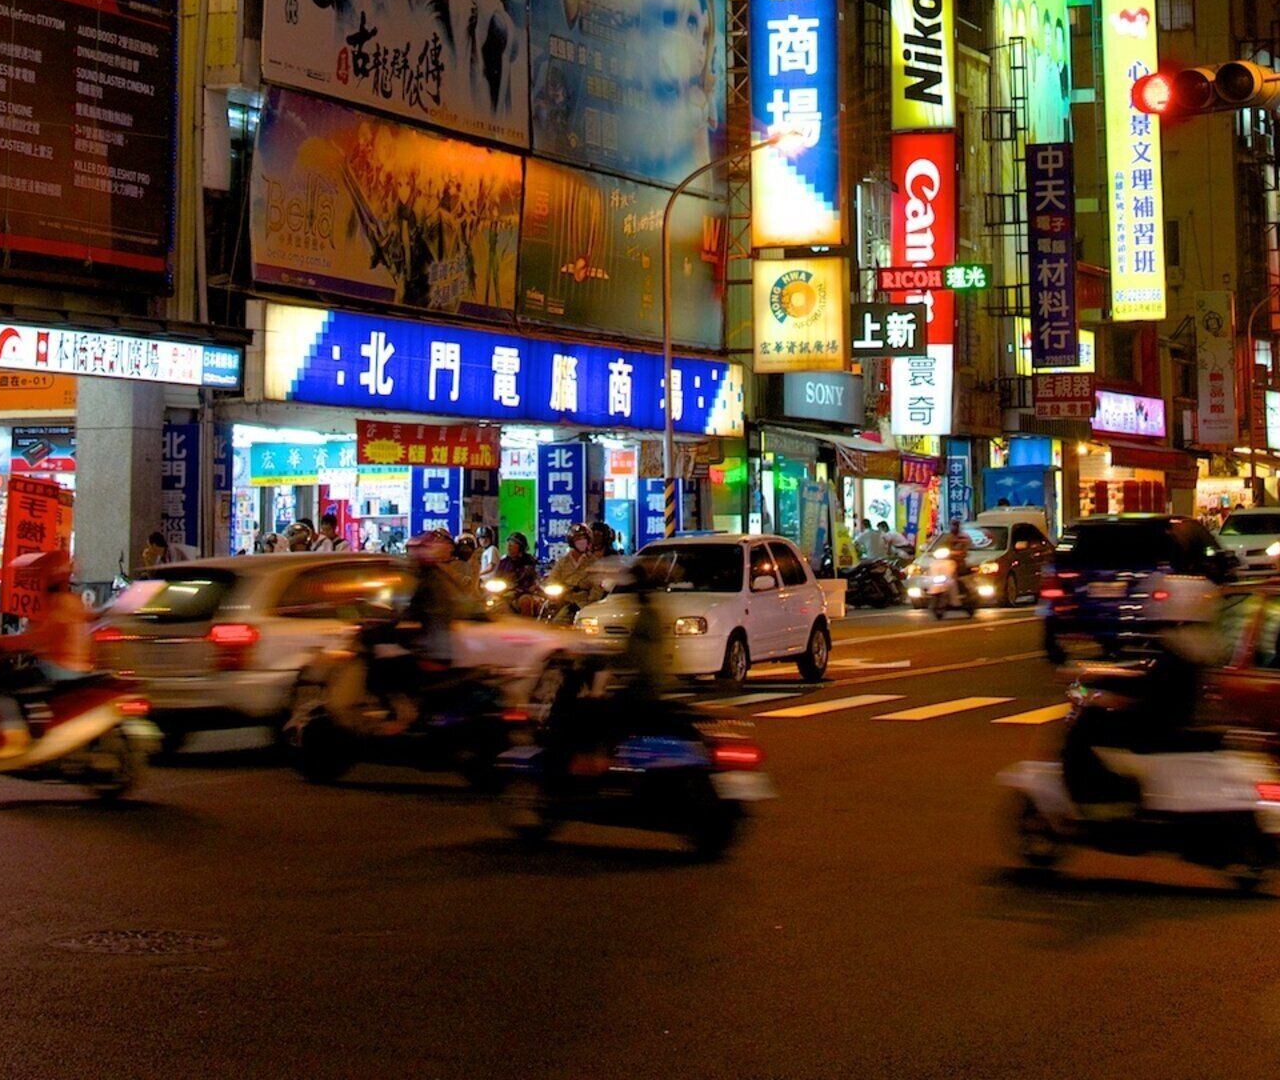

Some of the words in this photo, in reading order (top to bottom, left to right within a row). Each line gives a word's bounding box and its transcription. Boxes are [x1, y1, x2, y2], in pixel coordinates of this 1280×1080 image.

[882, 270, 943, 289] RICOH
[852, 311, 917, 350] 上新
[360, 331, 685, 422] 北門電腦商場
[805, 381, 845, 407] SONY
